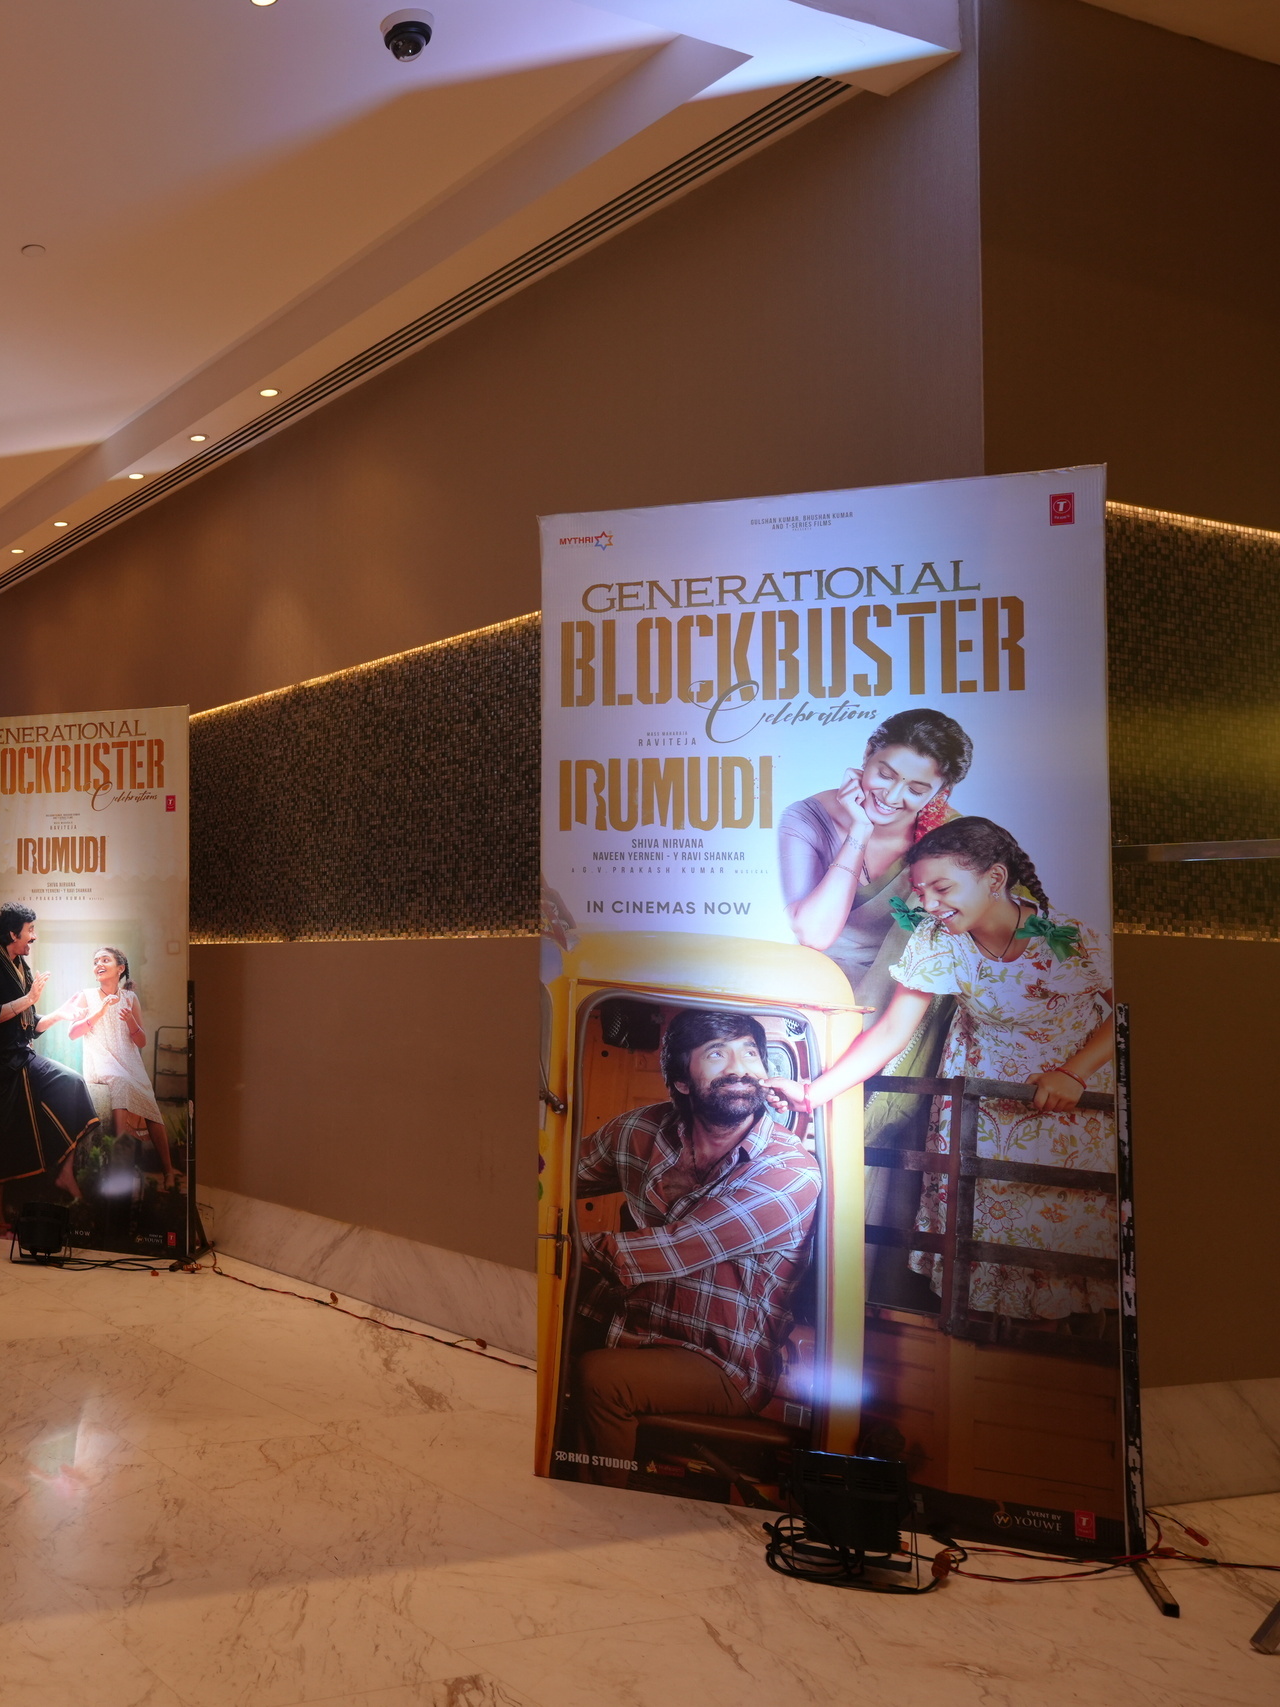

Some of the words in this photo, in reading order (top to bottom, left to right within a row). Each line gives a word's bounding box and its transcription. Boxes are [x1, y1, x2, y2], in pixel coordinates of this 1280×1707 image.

[559, 536, 594, 545] MYTHRI
[581, 560, 982, 614] GENERATIONAL
[560, 596, 1026, 708] BLOCKBUSTER
[687, 680, 879, 743] Celebrations
[638, 737, 697, 746] RAVITEJA
[558, 755, 773, 832] IRUMUDI
[631, 838, 659, 849] SHIVA
[662, 838, 704, 849] NIRVANA
[16, 835, 106, 875] IRUMUDI
[592, 851, 626, 861] NAVEEN
[627, 851, 664, 861] YERNENI
[673, 852, 679, 861] Y
[681, 851, 702, 861] RAVI
[703, 851, 745, 861] SHANKAR
[681, 866, 725, 874] KUMAR
[586, 900, 604, 914] IN
[611, 900, 696, 915] CINEMAS
[704, 902, 752, 915] NOW
[568, 1452, 590, 1465] RKD
[591, 1455, 638, 1471] STUDIOS
[1026, 1510, 1050, 1519] EVENT
[1014, 1516, 1063, 1532] YOUWE
